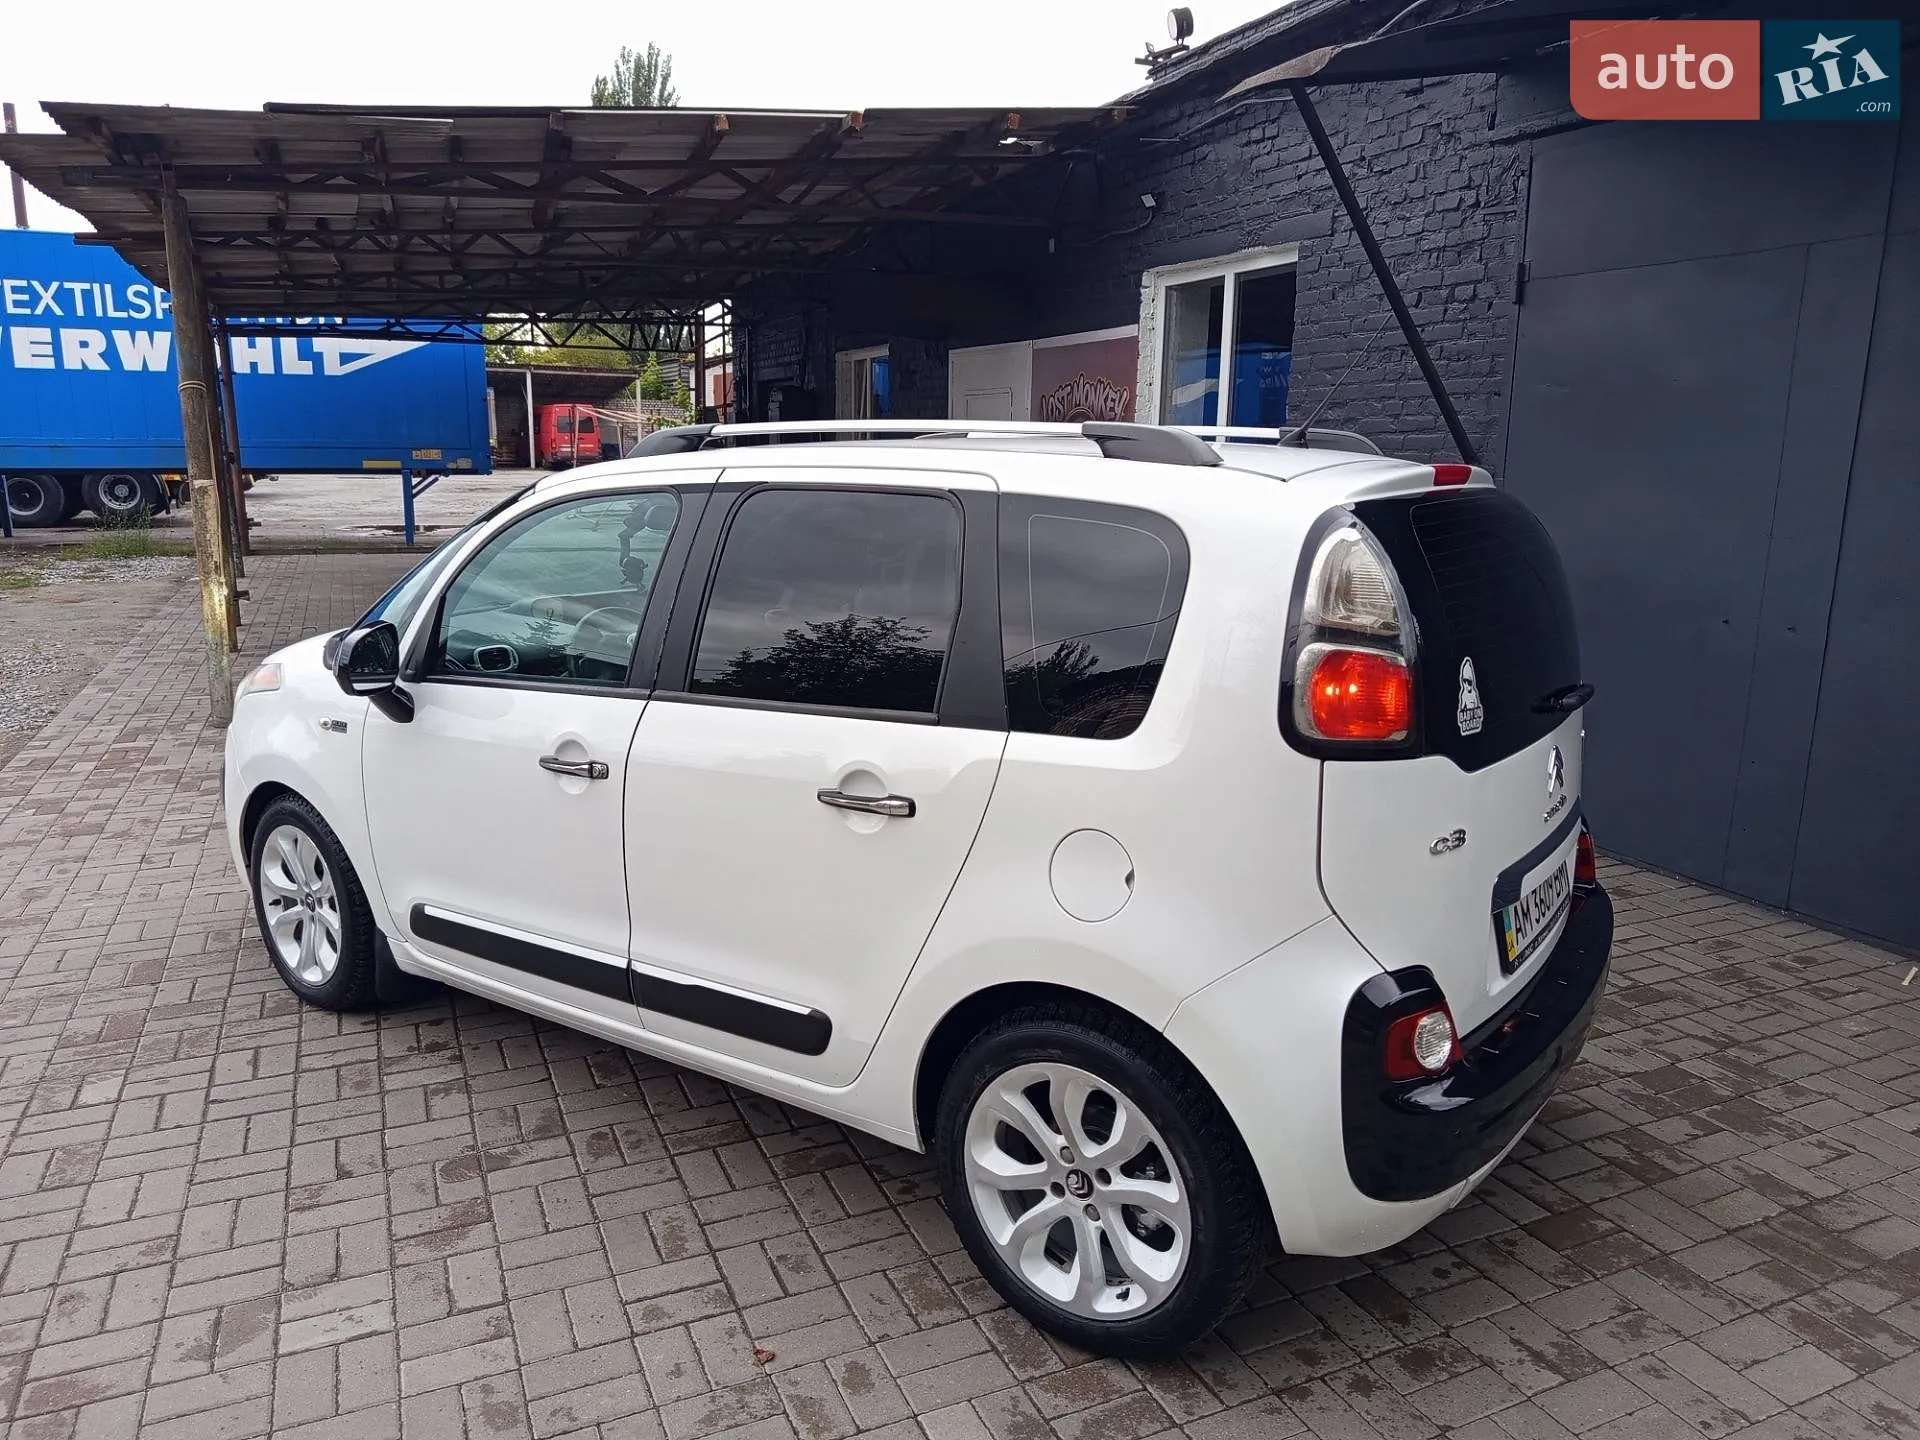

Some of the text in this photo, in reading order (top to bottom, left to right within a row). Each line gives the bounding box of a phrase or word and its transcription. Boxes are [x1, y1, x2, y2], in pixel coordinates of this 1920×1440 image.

[1071, 372, 1129, 421] MONKEY
[1429, 828, 1467, 855] C3
[1513, 894, 1534, 946] AM
